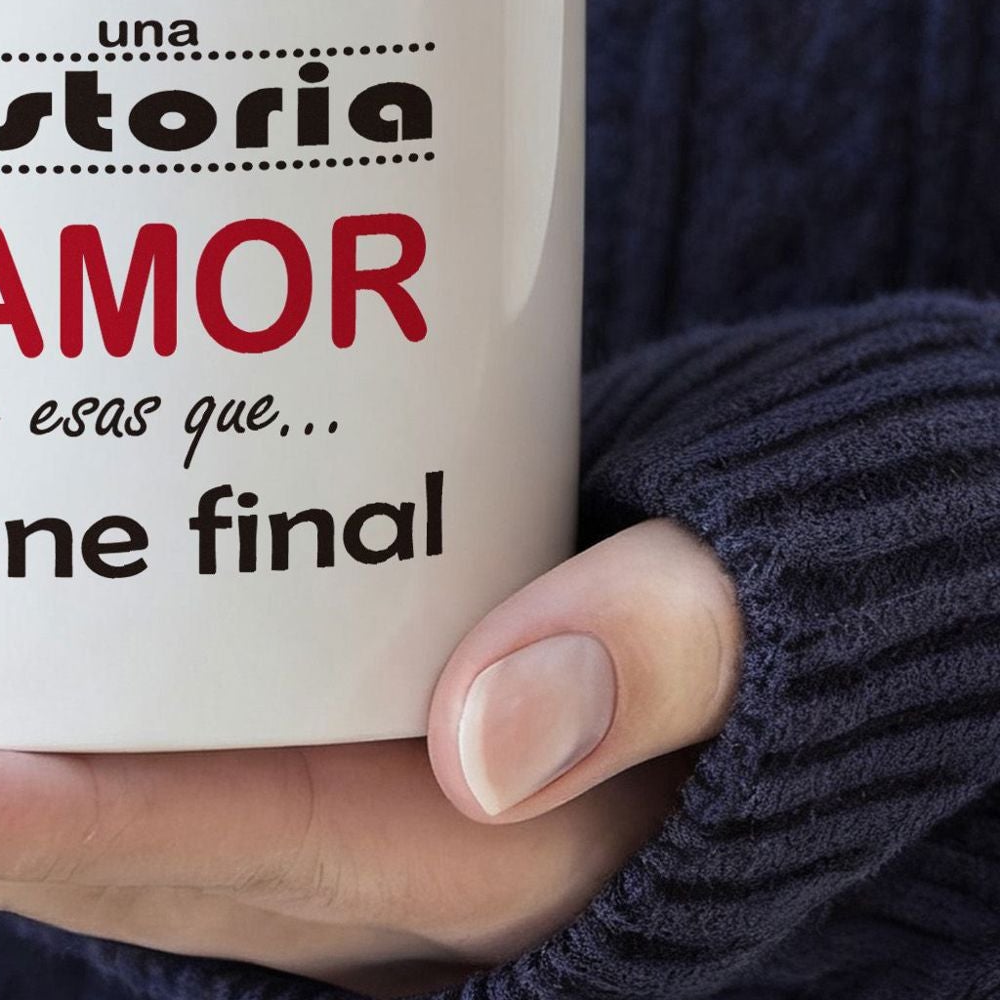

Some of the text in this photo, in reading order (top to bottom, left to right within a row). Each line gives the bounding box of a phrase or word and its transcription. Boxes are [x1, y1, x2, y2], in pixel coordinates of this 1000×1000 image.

[99, 20, 198, 47] una
[30, 395, 161, 438] esas
[184, 394, 338, 469] que...
[189, 470, 444, 575] final
